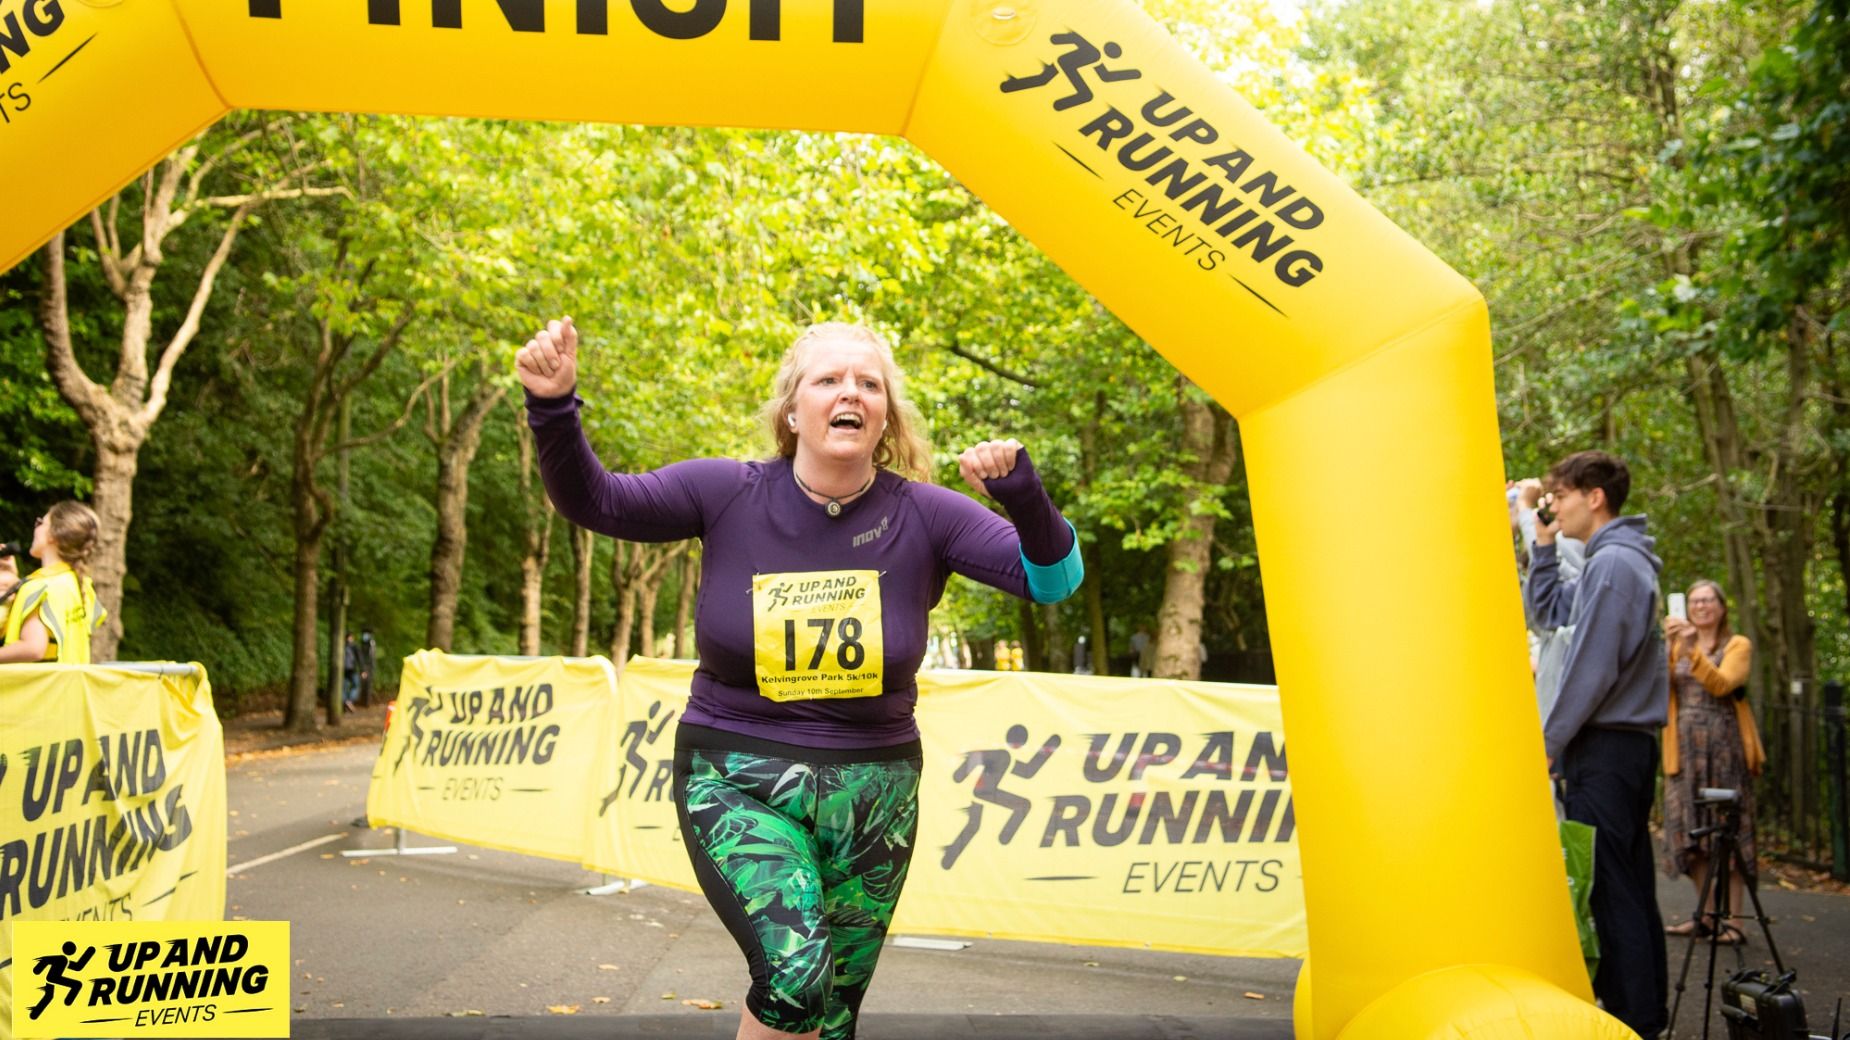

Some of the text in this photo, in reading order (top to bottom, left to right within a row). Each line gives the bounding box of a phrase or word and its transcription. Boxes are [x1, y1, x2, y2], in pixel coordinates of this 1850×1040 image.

[1141, 85, 1325, 230] UP AND
[1078, 103, 1324, 287] RUNNING
[1112, 188, 1226, 271] EVENTS
[792, 588, 866, 605] RUNNING
[799, 576, 857, 593] UP AND
[784, 617, 865, 671] 178
[761, 672, 878, 684] Kelvingrove Park 5k/10k
[778, 689, 805, 697] Sunday
[825, 687, 864, 695] September
[449, 683, 553, 725] UP AND
[421, 724, 560, 767] RUNNING
[1081, 731, 1288, 783] UP AN
[20, 728, 167, 822] UP AND
[442, 777, 504, 801] EVENTS
[1039, 788, 1296, 847] RUNNI
[1122, 859, 1284, 894] EVENTS
